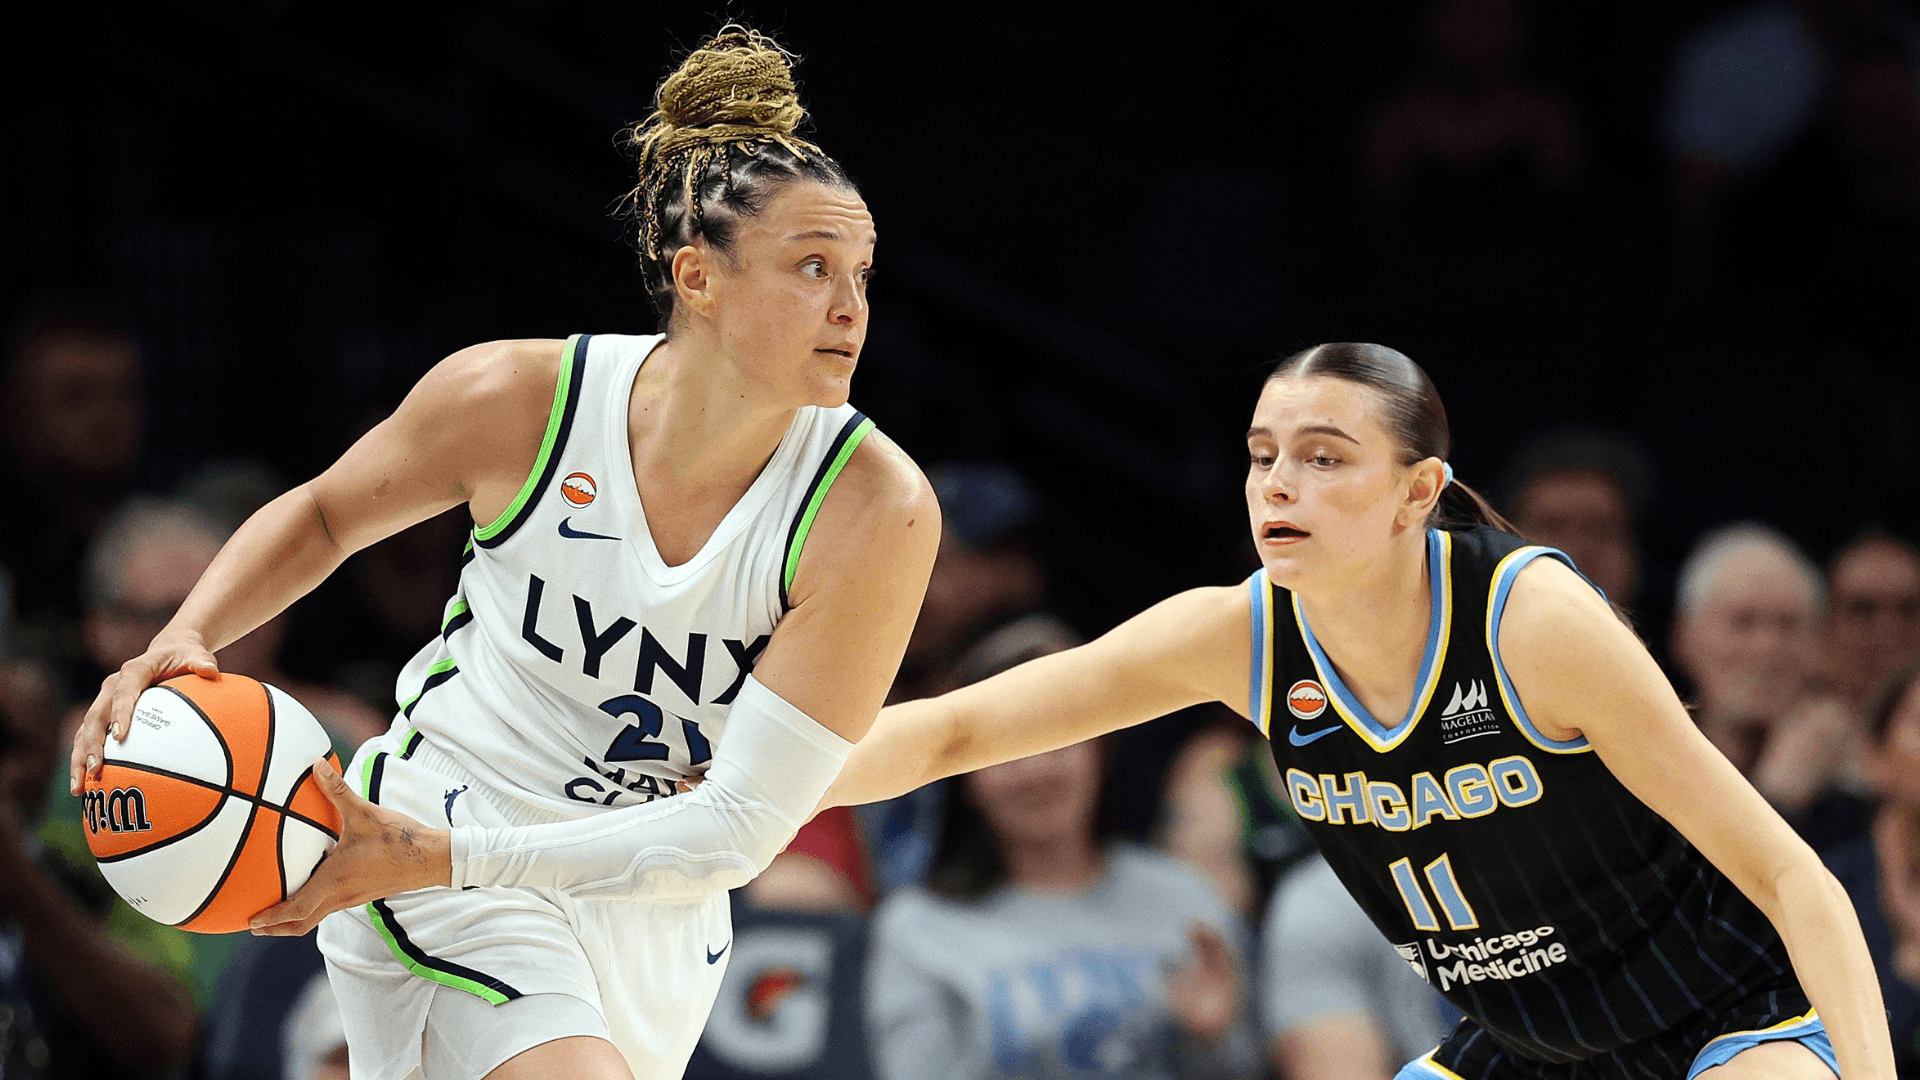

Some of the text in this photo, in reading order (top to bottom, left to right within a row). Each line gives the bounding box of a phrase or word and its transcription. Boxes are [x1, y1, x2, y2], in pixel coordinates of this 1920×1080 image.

[522, 573, 772, 706] LYNX
[598, 694, 713, 766] 21
[1441, 711, 1496, 731] MAGELLAN
[1442, 724, 1499, 740] CORPORATION
[1387, 851, 1480, 932] 11
[1436, 942, 1568, 992] Medicine
